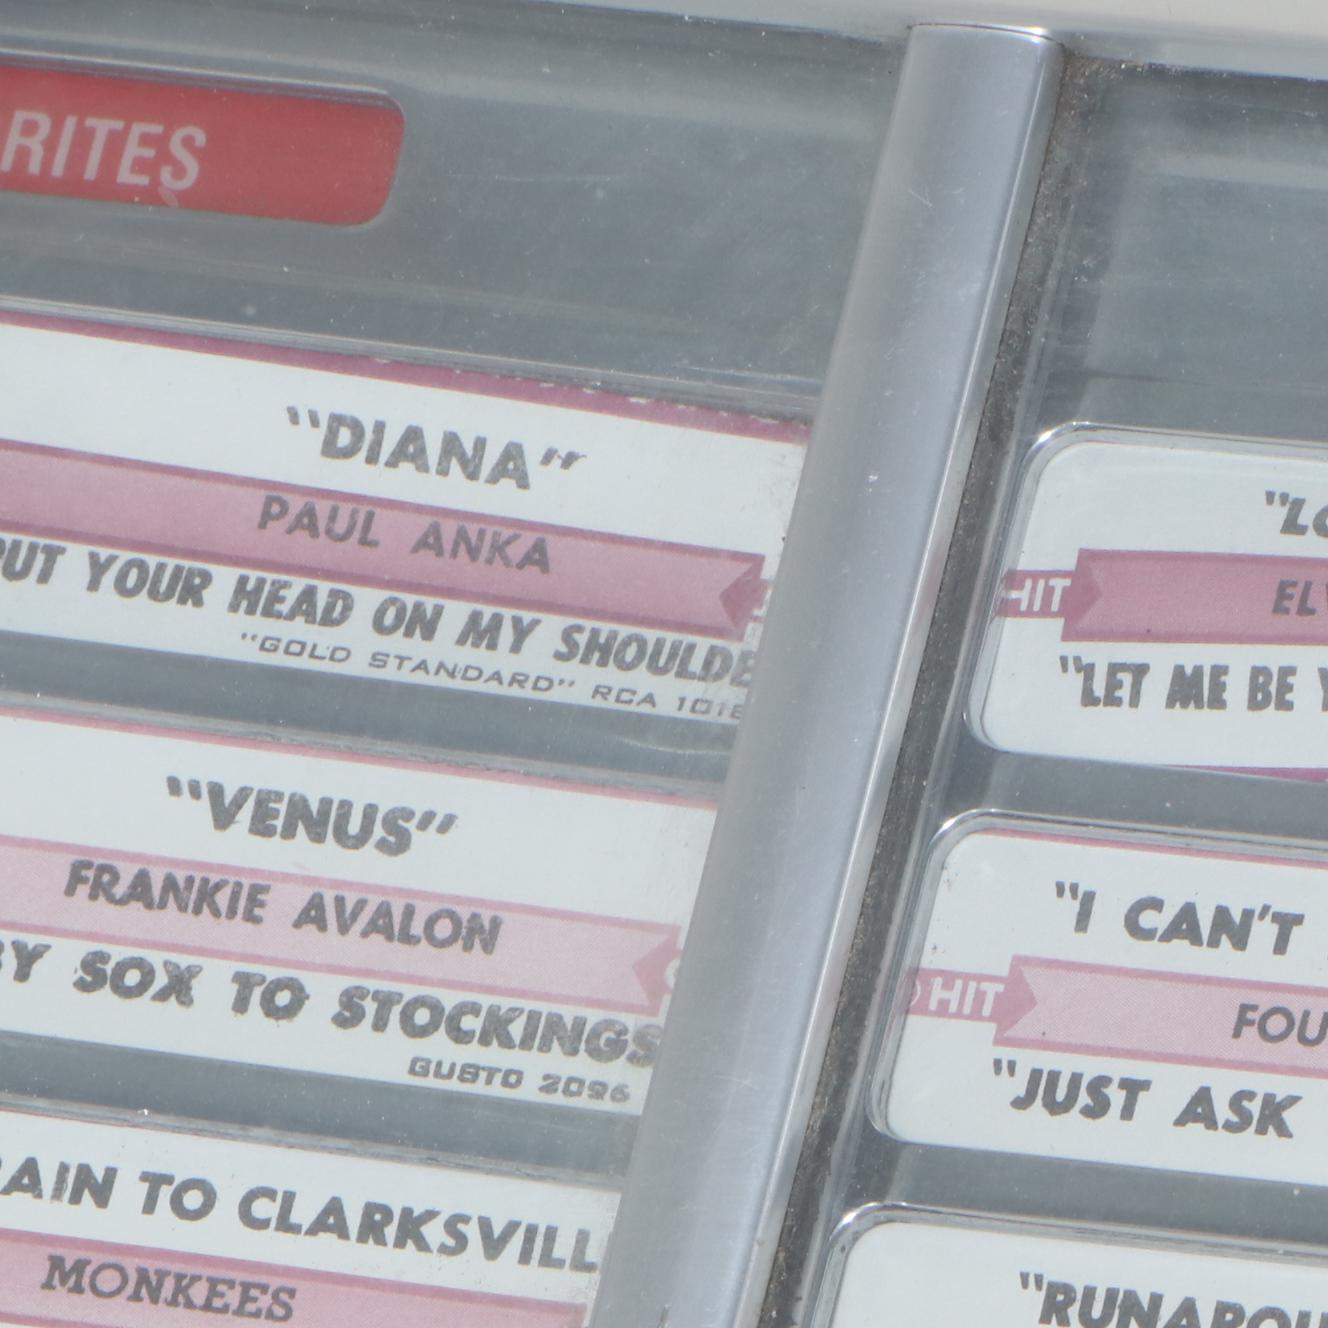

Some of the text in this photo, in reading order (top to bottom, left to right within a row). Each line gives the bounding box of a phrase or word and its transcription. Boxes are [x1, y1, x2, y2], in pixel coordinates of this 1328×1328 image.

[286, 405, 586, 491] "DIANA"
[257, 493, 550, 574] PAUL ANKA
[241, 631, 575, 693] "GOLD STANDARD"
[1058, 654, 1151, 709] "LET
[1164, 663, 1230, 711] ME
[1246, 664, 1298, 712] BE
[165, 774, 458, 857] "VENUS"
[63, 858, 504, 955] FRANKIE AVALON
[1054, 880, 1097, 934] "I
[1123, 895, 1306, 956] CAN'T
[992, 1057, 1153, 1122] "JUST
[1172, 1084, 1304, 1139] ASK
[39, 1253, 298, 1323] MONKEES
